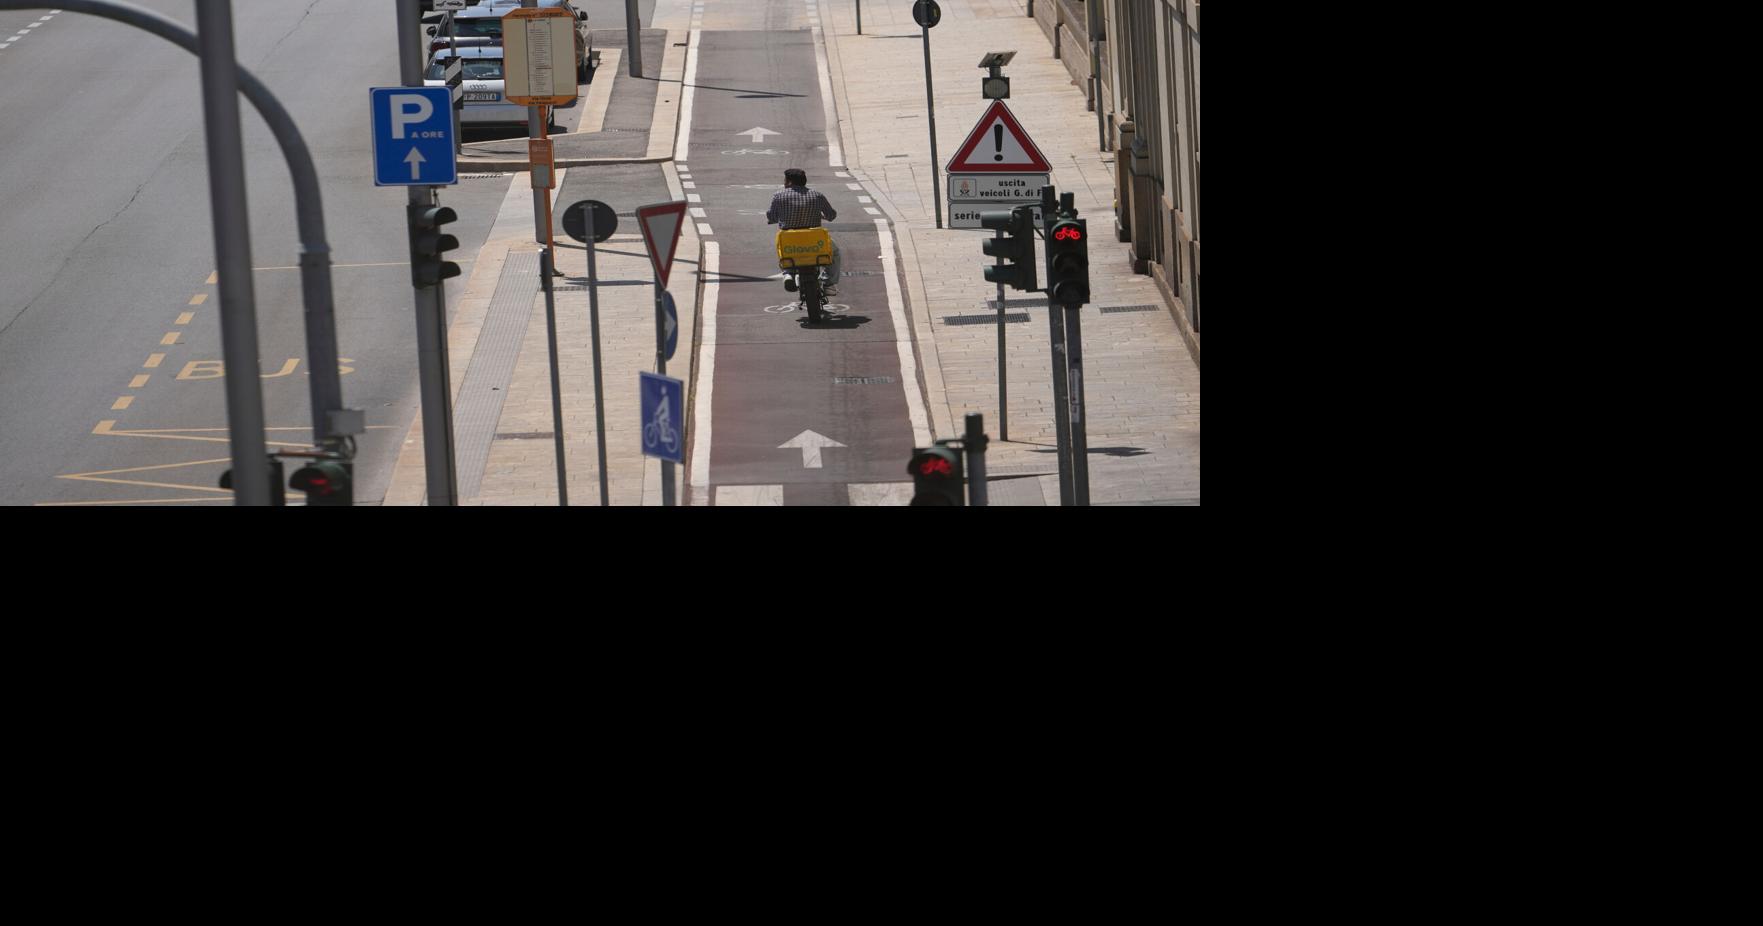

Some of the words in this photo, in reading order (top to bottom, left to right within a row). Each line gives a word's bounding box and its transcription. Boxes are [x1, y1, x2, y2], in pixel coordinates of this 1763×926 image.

[390, 94, 433, 139] P
[999, 179, 1026, 187] uscita
[980, 189, 1010, 197] veicoli
[1014, 189, 1024, 197] G.
[1025, 189, 1034, 197] di
[954, 211, 981, 220] serie
[784, 241, 823, 254] Glovo
